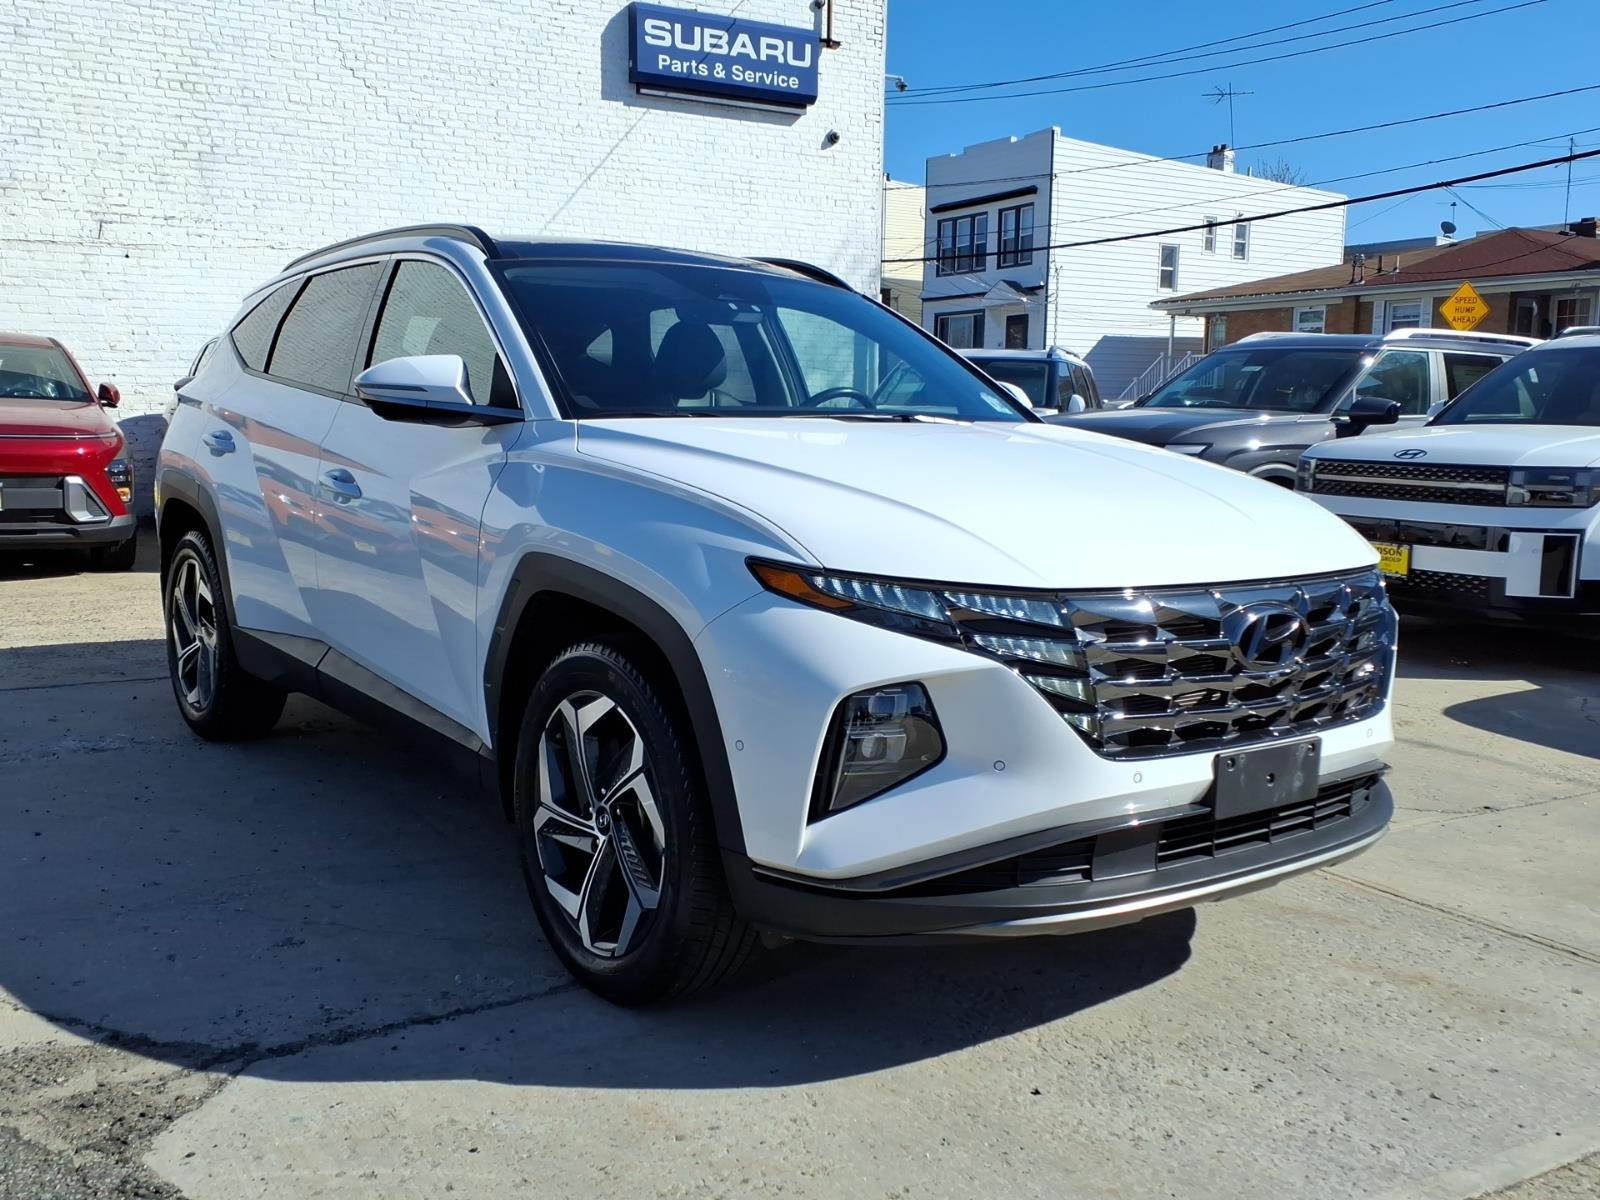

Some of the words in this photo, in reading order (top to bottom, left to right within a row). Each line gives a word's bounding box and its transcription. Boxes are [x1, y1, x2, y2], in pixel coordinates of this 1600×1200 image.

[644, 18, 812, 67] SUBARU
[658, 54, 708, 76] Parts
[713, 62, 726, 79] &
[732, 65, 799, 88] Service
[1452, 316, 1477, 324] AHEAD
[1376, 546, 1402, 556] DSON
